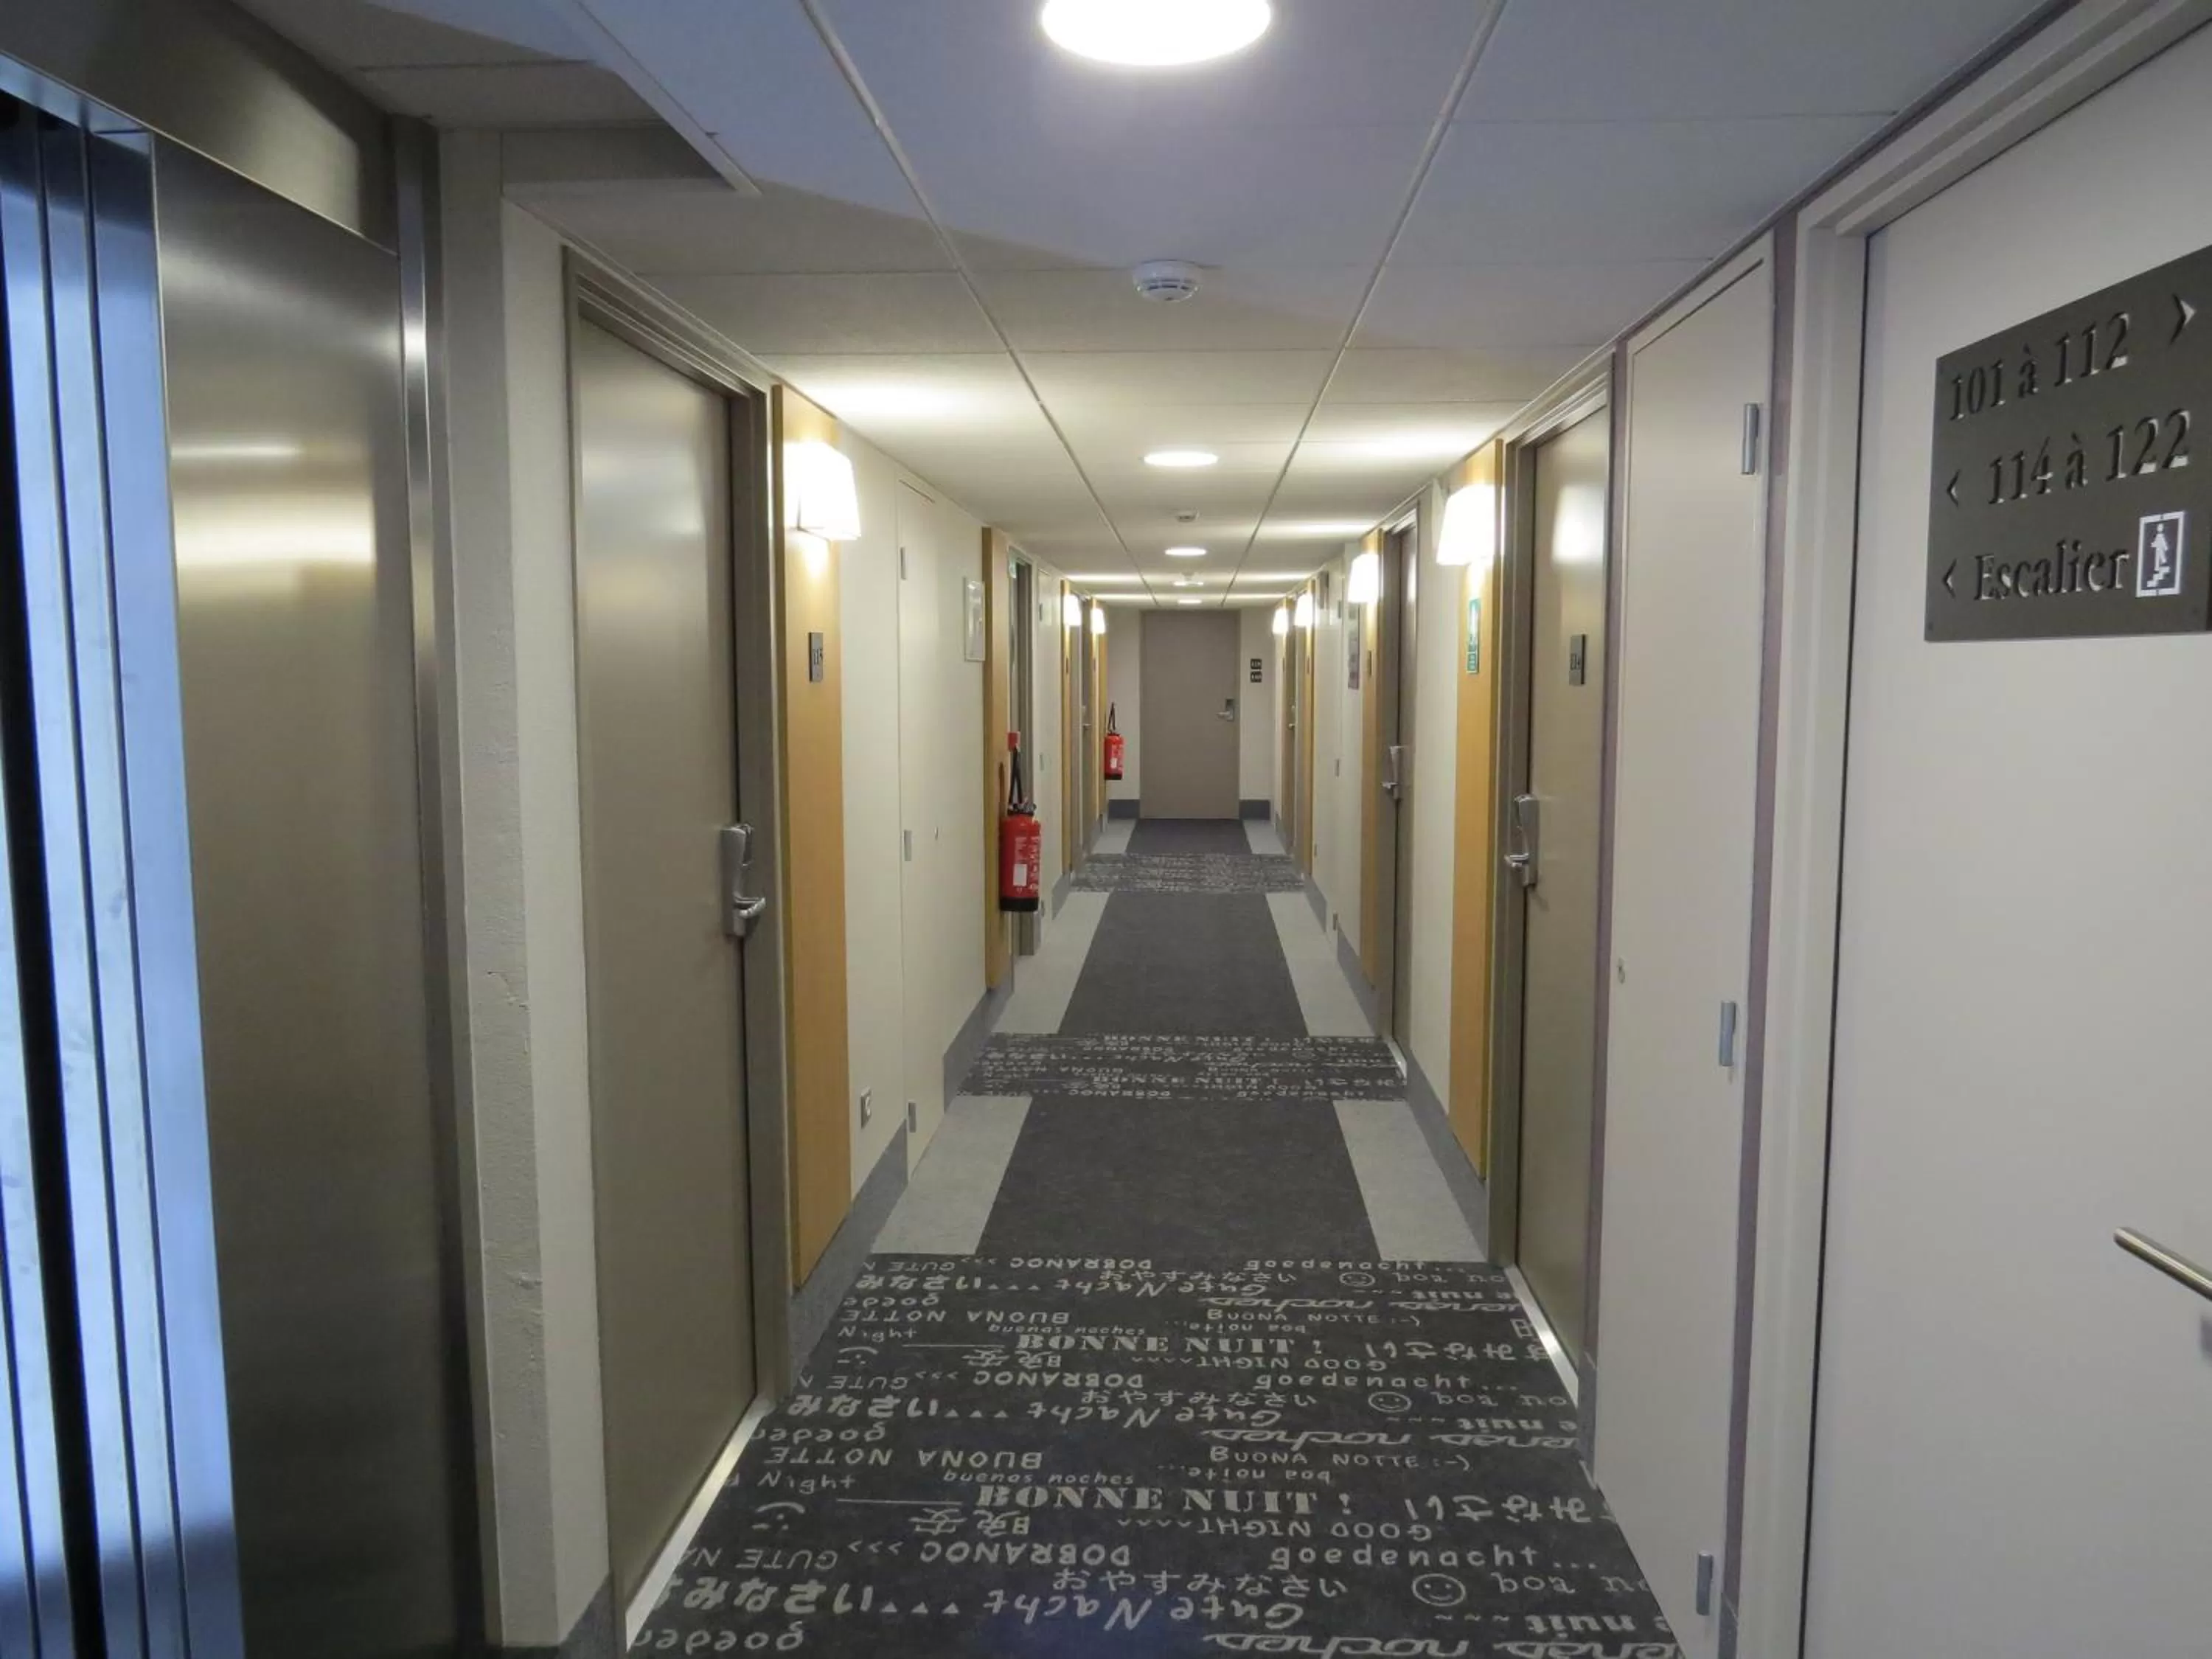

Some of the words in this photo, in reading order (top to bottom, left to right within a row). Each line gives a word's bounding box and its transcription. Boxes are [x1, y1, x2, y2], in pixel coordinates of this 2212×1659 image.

[1949, 358, 2006, 421] 101
[2017, 343, 2039, 399] à
[2053, 312, 2129, 387] 112
[1989, 437, 2053, 504] 114
[2065, 433, 2088, 490] à
[2105, 408, 2190, 482] 122
[1974, 539, 2130, 601] Escalier
[1009, 1256, 1152, 1270] DOBRANOC
[841, 1309, 947, 1323] NOTTE
[966, 1310, 1071, 1324] BUONA
[1015, 1335, 1169, 1353] BONNE
[1184, 1336, 1296, 1354] NUIT
[1195, 1356, 1290, 1369] NIGHT
[1304, 1358, 1388, 1372] GOOD
[824, 1374, 910, 1391] GUTE
[972, 1370, 1144, 1389] DOBRANOC
[1026, 1400, 1162, 1429] Nacht
[1174, 1405, 1282, 1427] Gute
[1199, 1428, 1413, 1453] noches
[762, 1445, 894, 1466] NOTTE
[917, 1447, 1043, 1470] BUONA
[975, 1485, 1166, 1511] BONNE
[1180, 1488, 1320, 1515] NUIT
[1196, 1518, 1312, 1539] NIGHT
[1329, 1521, 1433, 1543] GOOD
[734, 1547, 839, 1571] GUTE
[919, 1540, 1132, 1567] DOBRANOC
[1051, 1567, 1349, 1599] おやすみなさい
[981, 1587, 1154, 1632] Nacht
[1169, 1593, 1304, 1630] Gute
